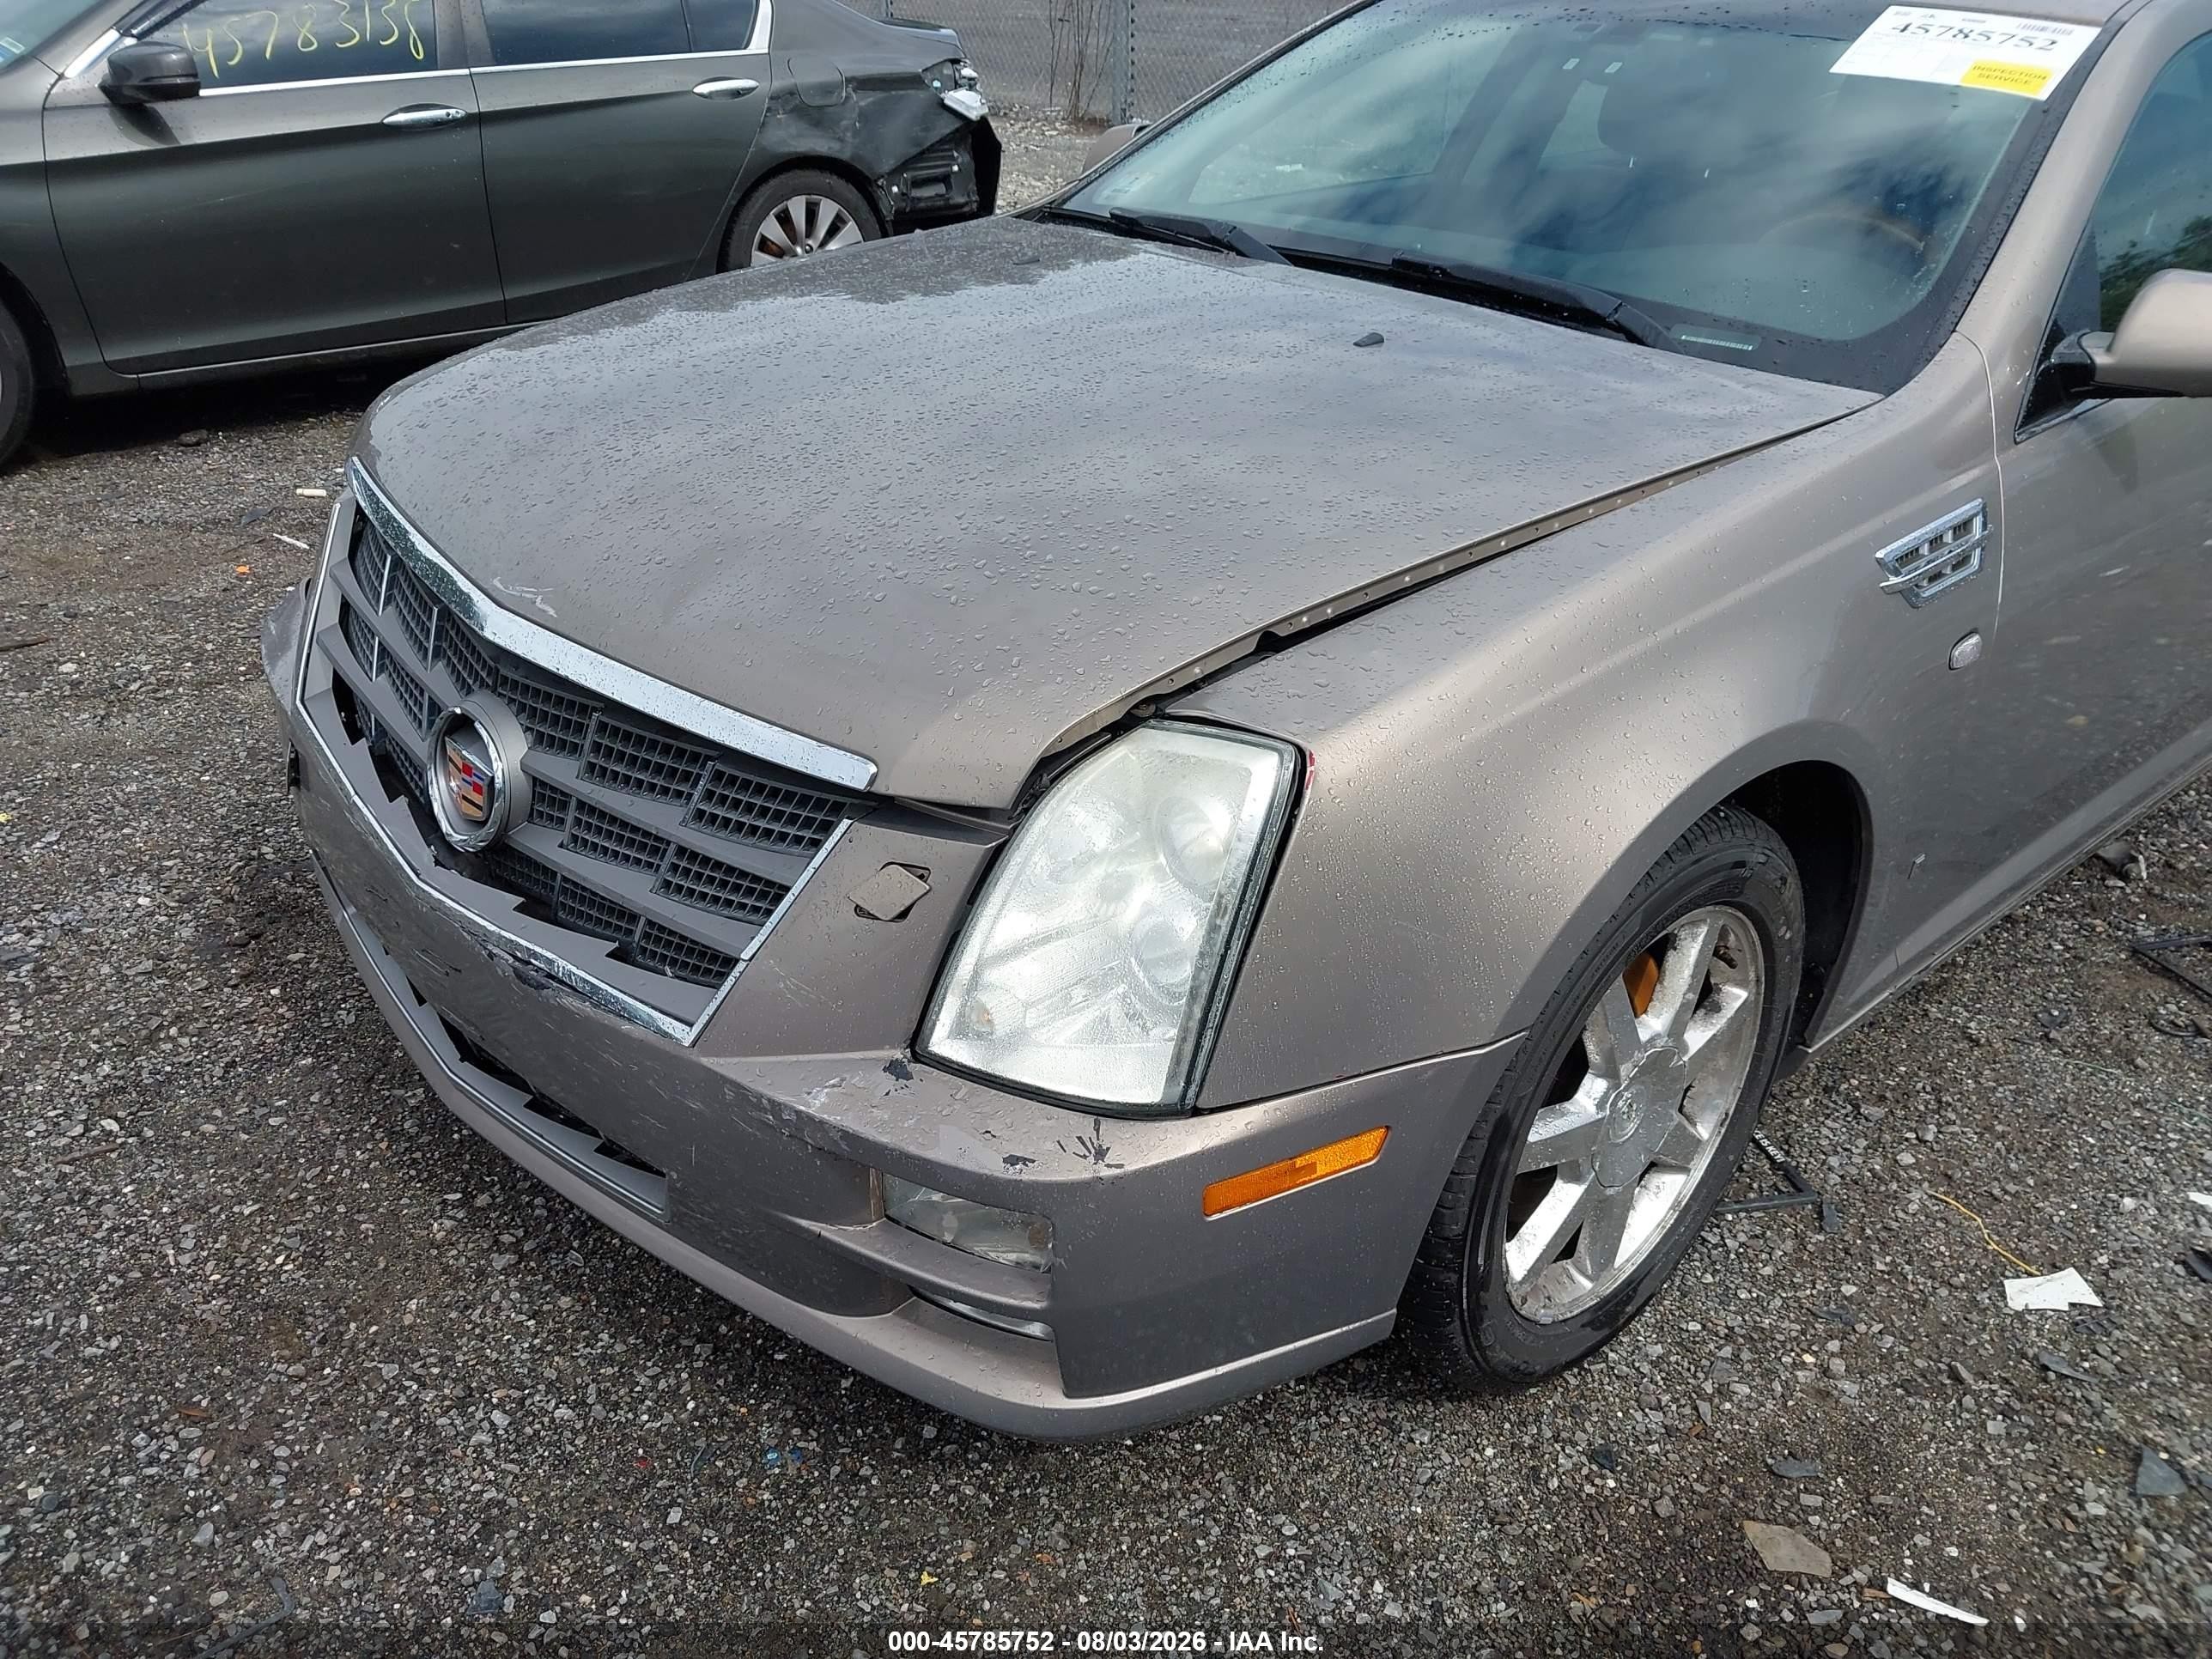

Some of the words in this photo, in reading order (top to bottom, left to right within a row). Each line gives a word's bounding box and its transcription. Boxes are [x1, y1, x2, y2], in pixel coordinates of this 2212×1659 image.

[1891, 21, 2059, 52] 45785752
[1972, 64, 2048, 81] INSPECTION
[1978, 72, 2033, 85] SERVICE
